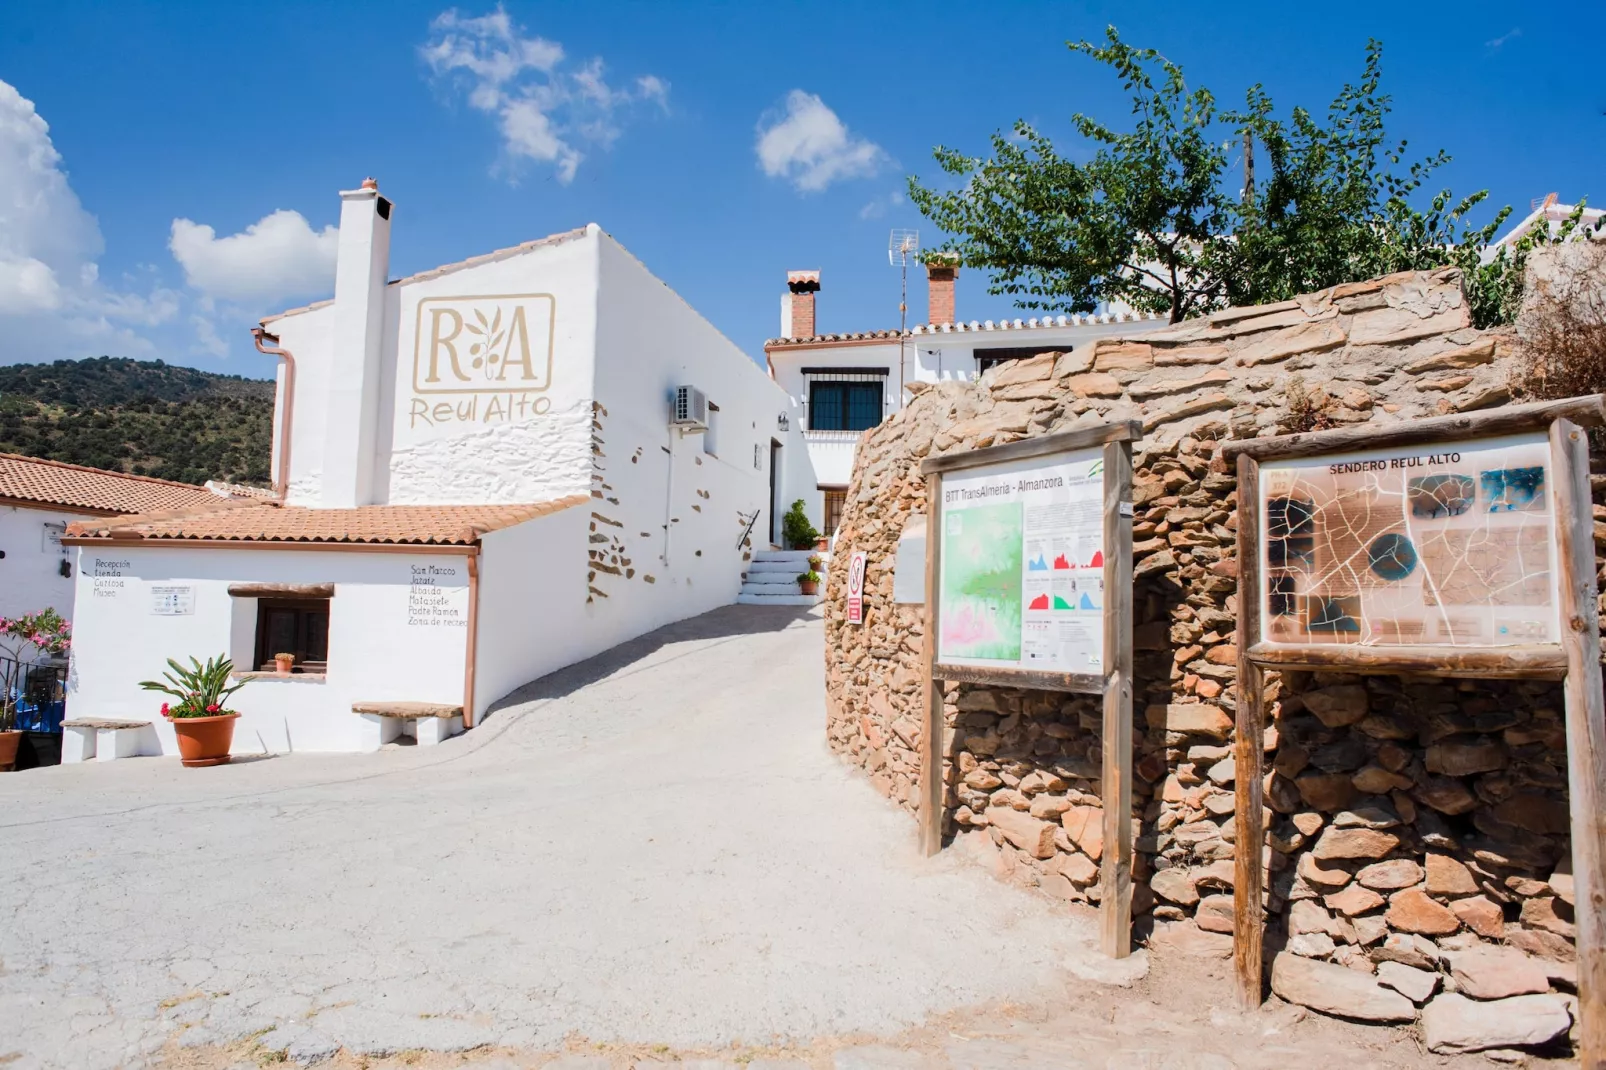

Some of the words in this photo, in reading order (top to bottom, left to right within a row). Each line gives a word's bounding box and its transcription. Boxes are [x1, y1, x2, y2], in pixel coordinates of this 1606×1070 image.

[408, 394, 478, 429] Reul
[483, 392, 552, 424] Alto
[1329, 460, 1387, 475] SENDERO
[1391, 456, 1424, 469] REUL
[1428, 452, 1461, 465] ALTO
[945, 489, 960, 503] BTT
[1017, 475, 1063, 492] Almanzora
[95, 558, 131, 570] Recepción
[94, 569, 121, 577] tienda
[411, 564, 427, 575] San
[428, 565, 456, 576] Marcos
[93, 588, 116, 598] Museo
[409, 595, 450, 606] Matasiete
[408, 605, 431, 616] Padre
[408, 616, 429, 626] Zona
[431, 617, 441, 626] de
